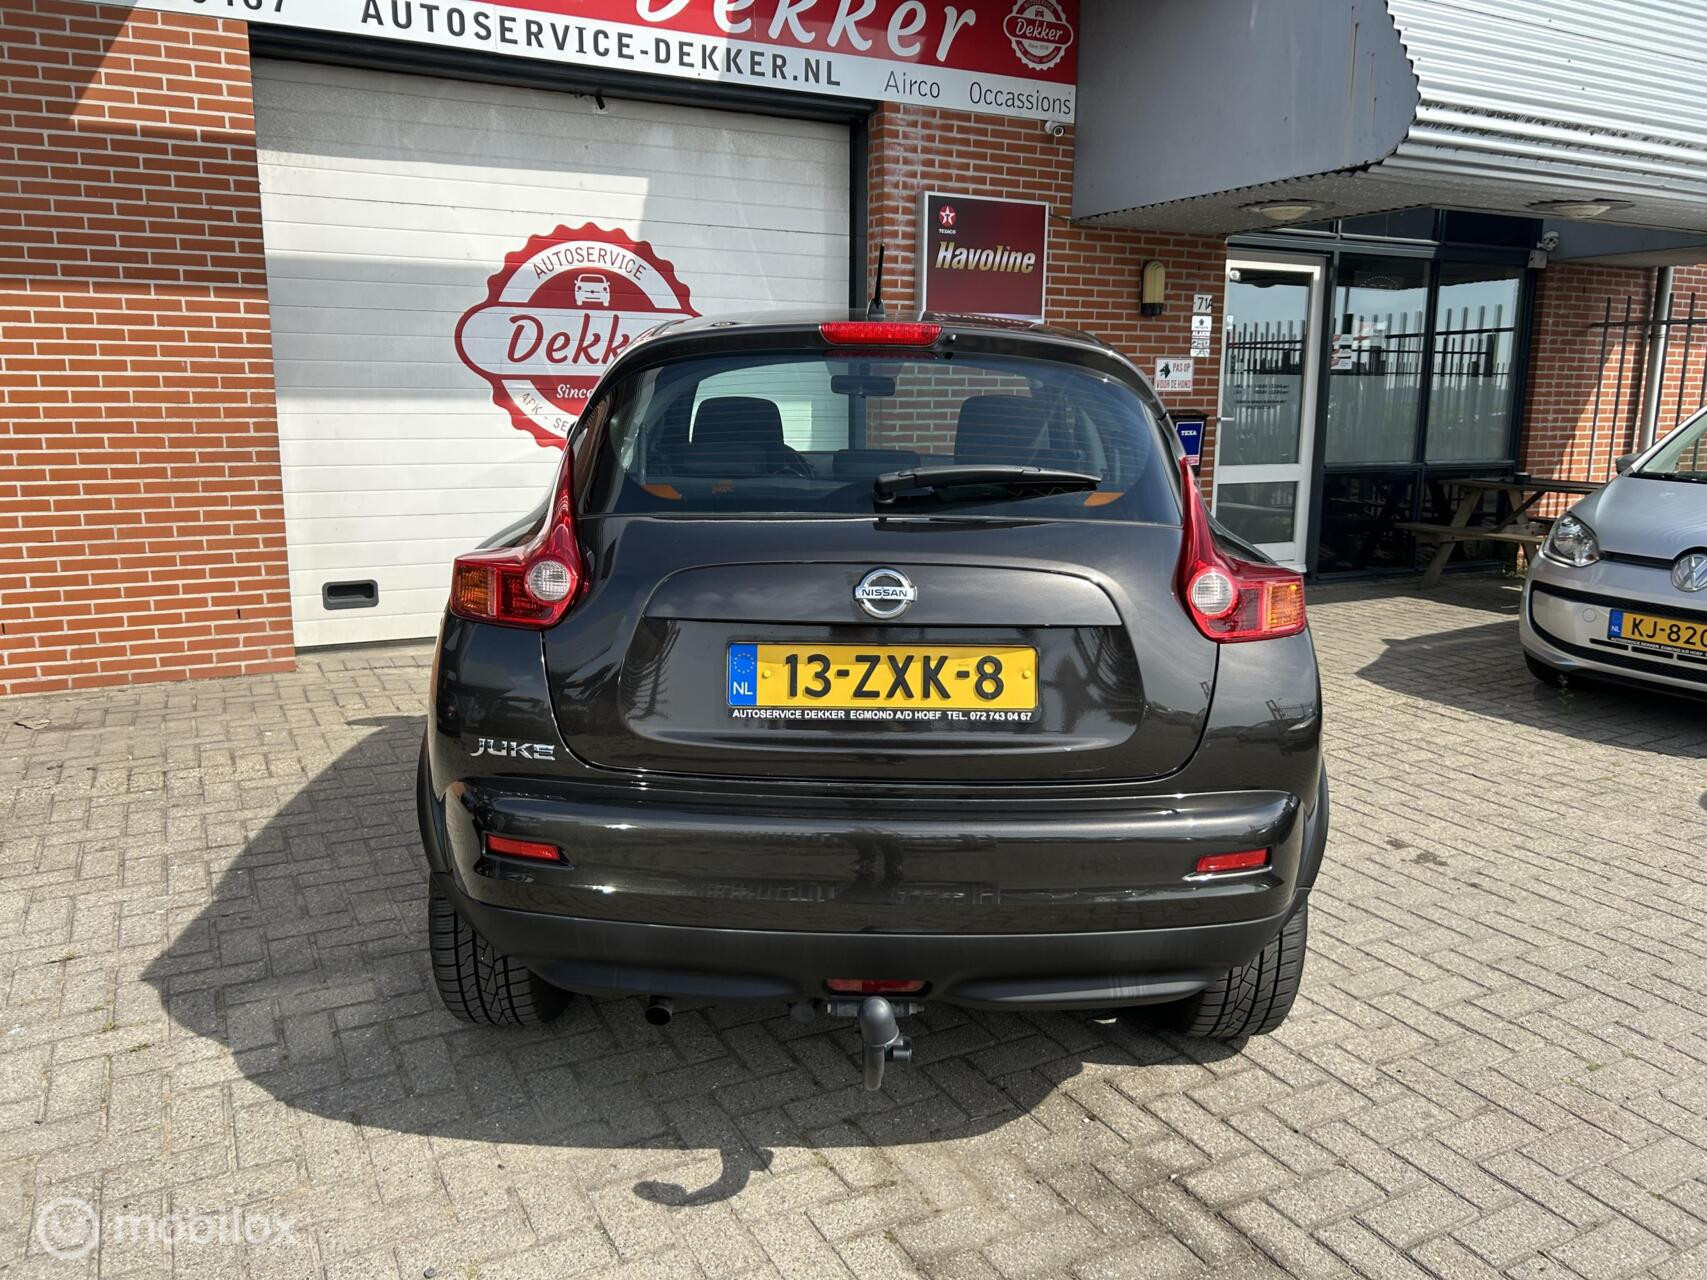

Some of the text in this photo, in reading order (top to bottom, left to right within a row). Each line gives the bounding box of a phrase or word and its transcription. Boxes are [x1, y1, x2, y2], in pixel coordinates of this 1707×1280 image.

[1016, 18, 1063, 41] Dekker
[361, 0, 841, 87] AUTOSERVICE-DEKKER.NL
[884, 70, 1071, 115] Airco Occassions
[533, 246, 647, 281] AUTOSERVICE
[935, 241, 1036, 274] Havoline
[507, 312, 631, 365] Dekk
[1172, 362, 1191, 373] PAS OP
[1156, 379, 1170, 389] VOOR
[1171, 379, 1177, 389] DE
[520, 392, 543, 416] APK
[861, 588, 907, 598] NISSAN
[1611, 625, 1621, 633] NL
[733, 682, 753, 696] NL
[785, 653, 1005, 701] 13-ZXK-8
[732, 709, 1032, 721] AUTOSERVICE DEKKER EGMOND A/D HOEF TEL. 072 743 04 67
[469, 737, 556, 761] JUKE
